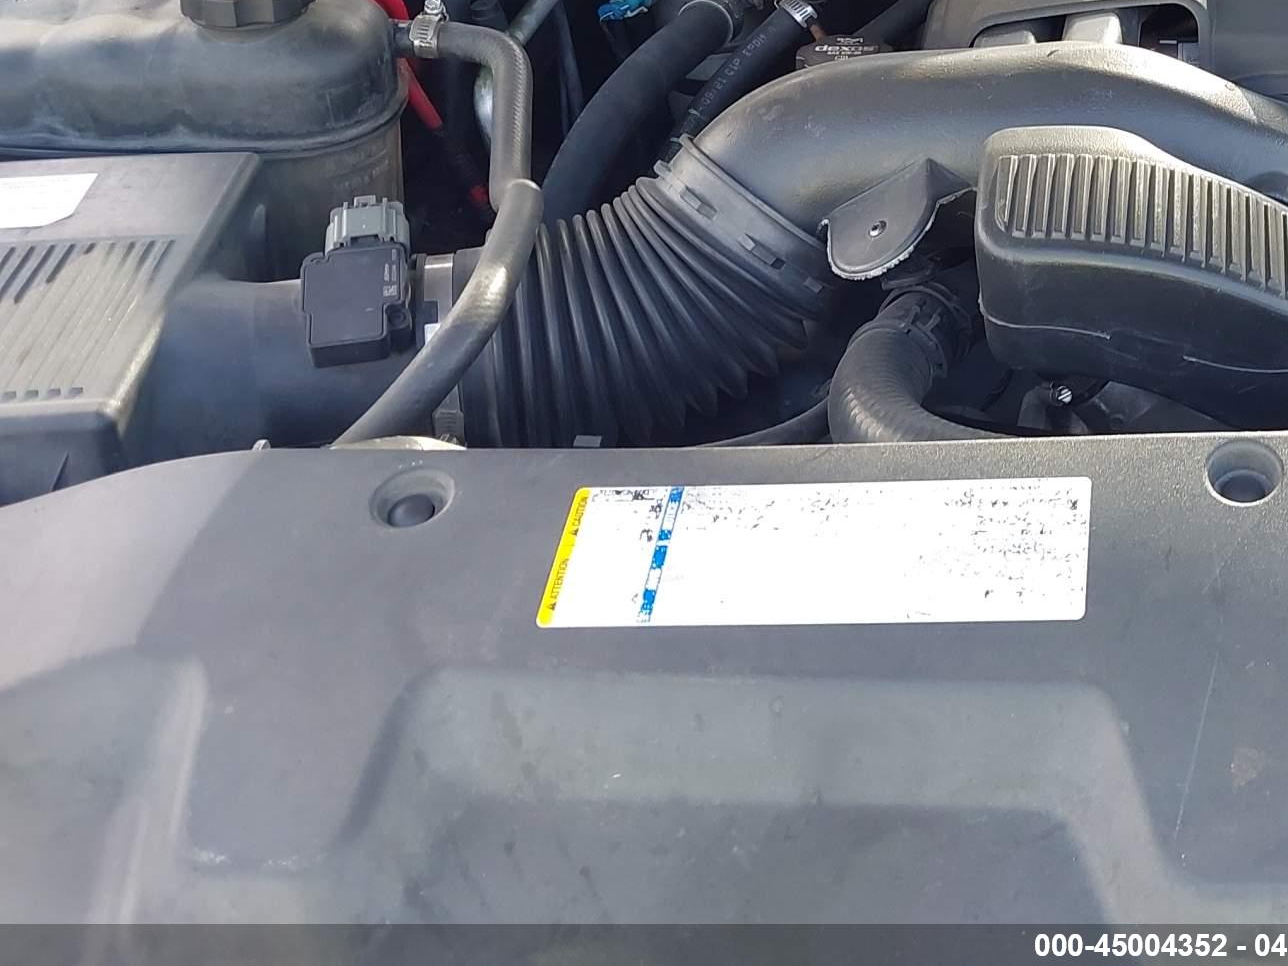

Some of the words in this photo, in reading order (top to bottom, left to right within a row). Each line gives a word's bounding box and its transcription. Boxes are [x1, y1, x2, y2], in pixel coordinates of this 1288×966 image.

[815, 44, 876, 52] dexos
[571, 495, 589, 527] CAUTION
[550, 557, 569, 601] ATTENTION
